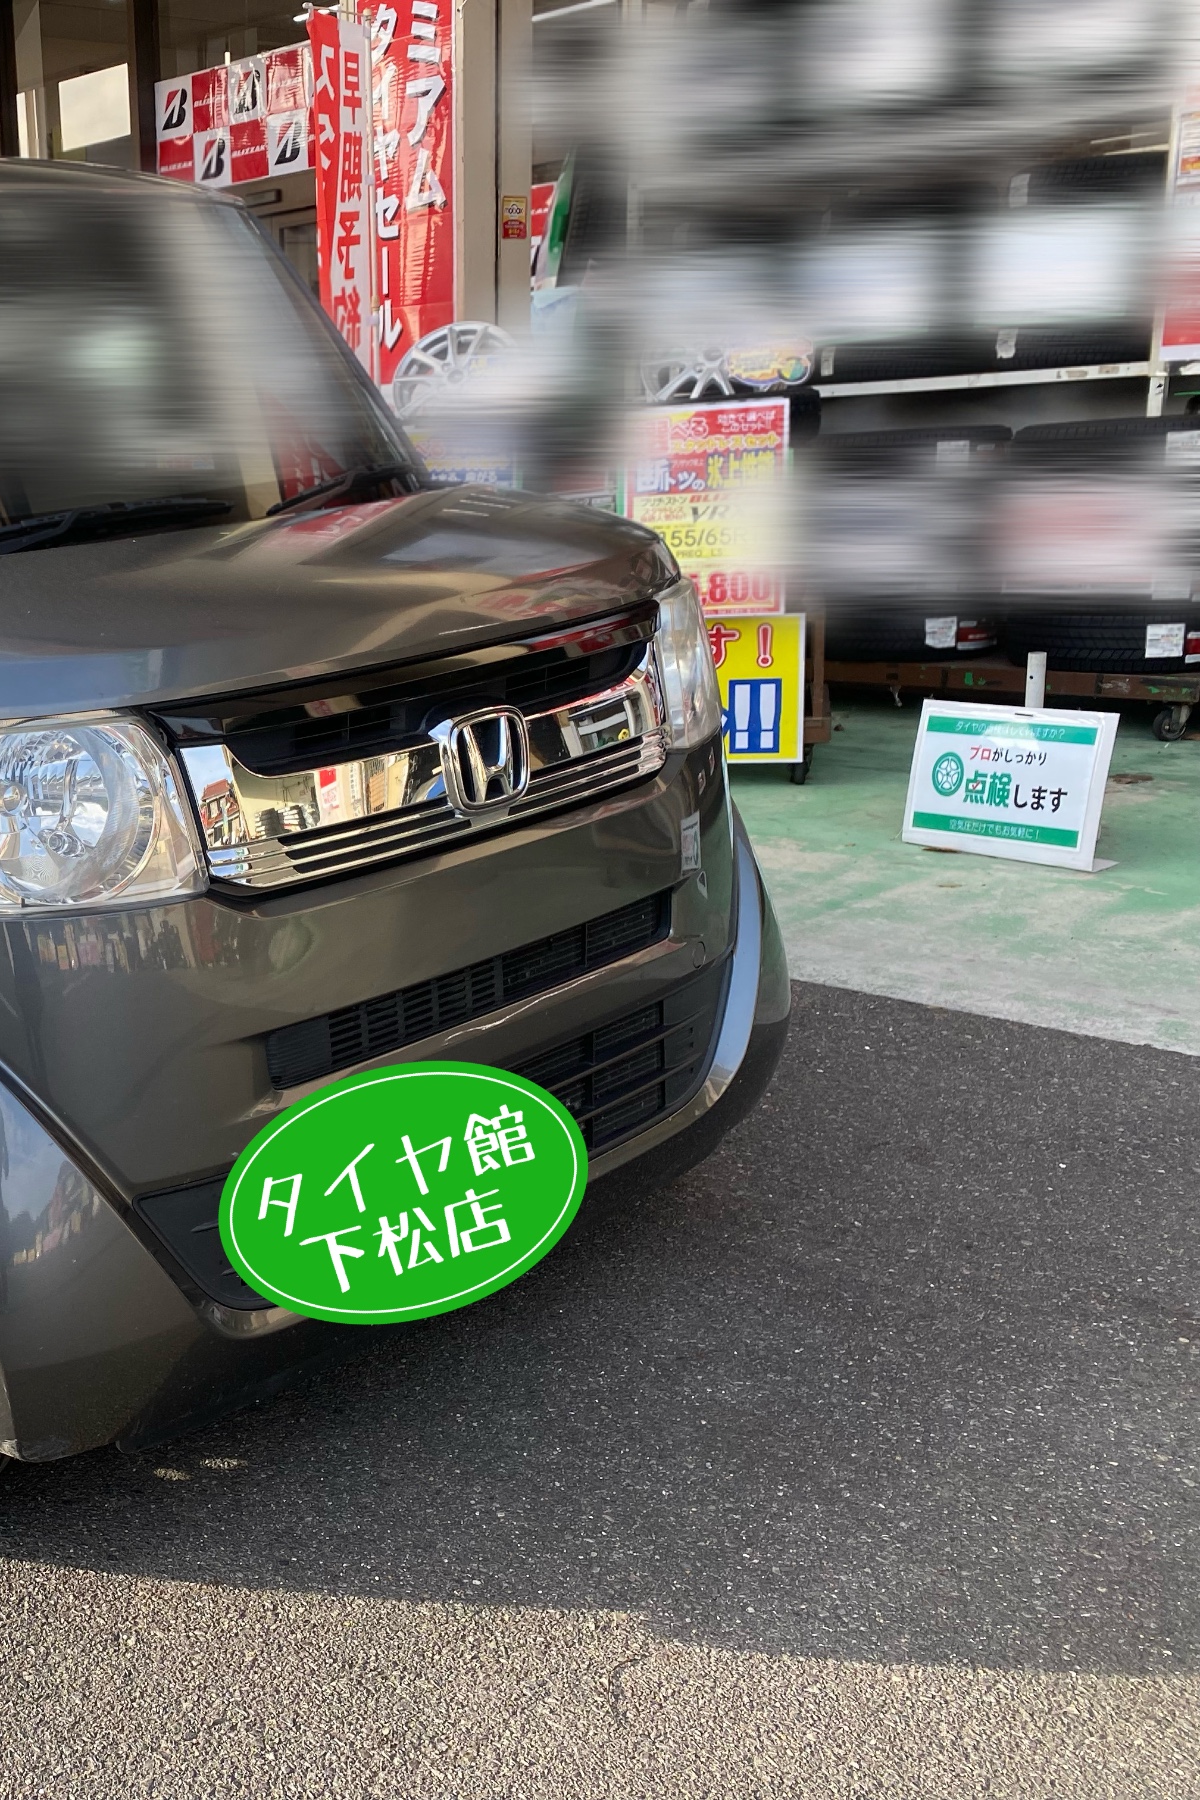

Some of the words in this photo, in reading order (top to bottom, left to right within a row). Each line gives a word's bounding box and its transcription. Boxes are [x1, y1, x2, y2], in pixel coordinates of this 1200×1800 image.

[231, 144, 268, 157] BLIZZAK
[969, 746, 1048, 766] プロがしっかり
[963, 770, 1068, 813] 点検します
